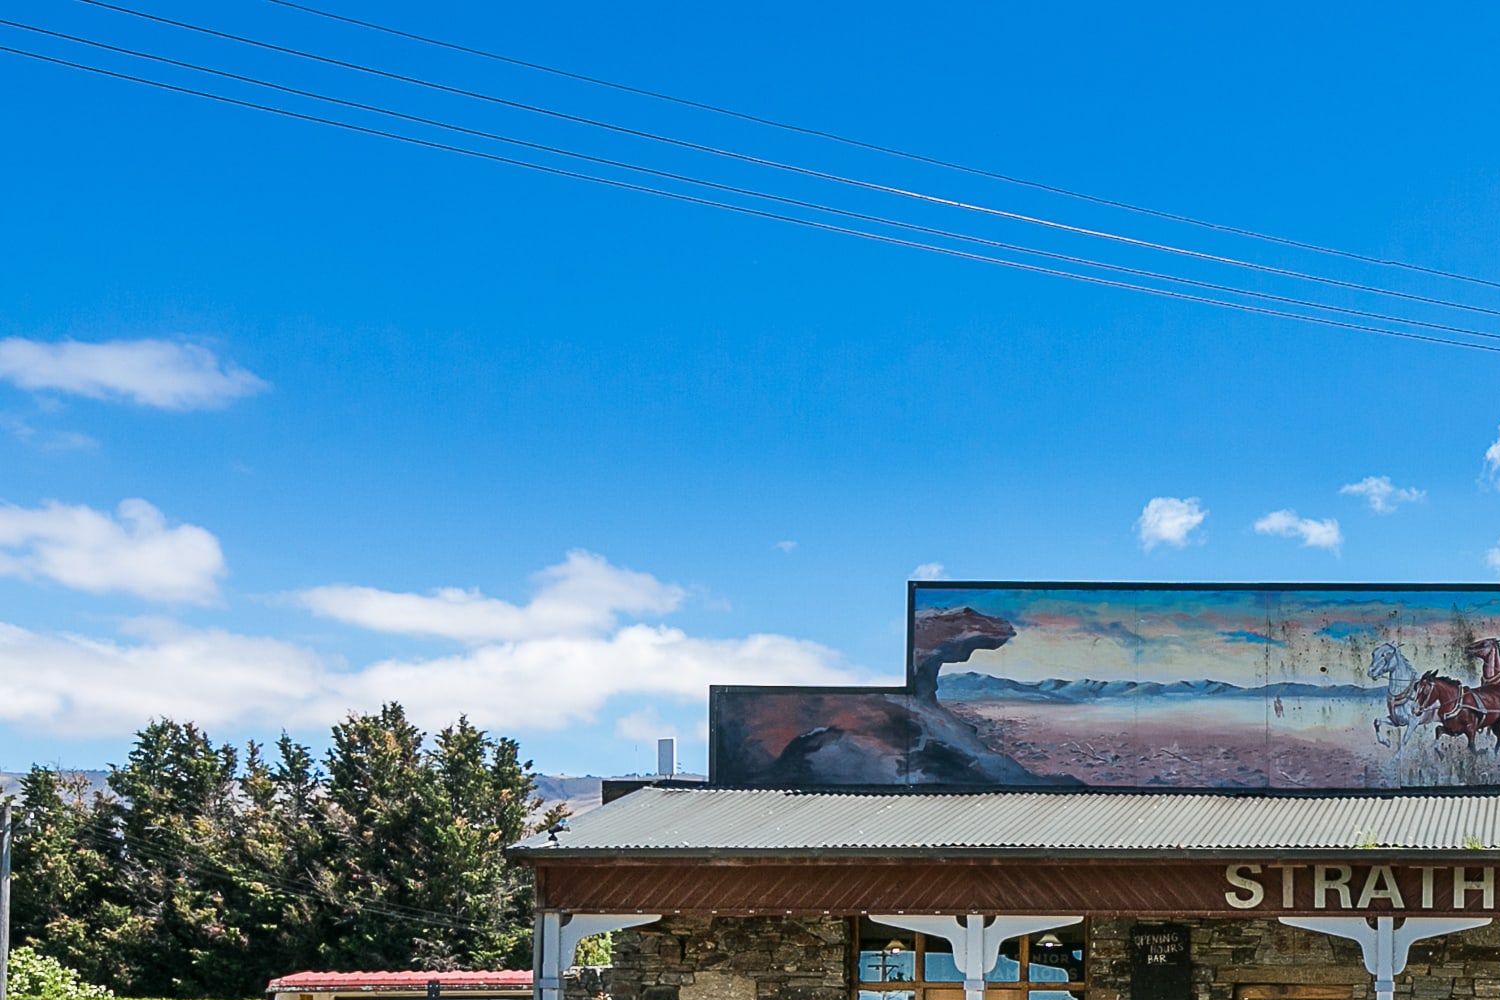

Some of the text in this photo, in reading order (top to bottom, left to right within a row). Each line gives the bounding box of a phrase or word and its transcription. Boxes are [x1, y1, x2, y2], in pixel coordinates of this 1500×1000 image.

[1225, 864, 1494, 909] STRATH
[1134, 932, 1179, 948] OPENING
[1150, 943, 1184, 954] HOURS
[1147, 954, 1167, 965] BAR
